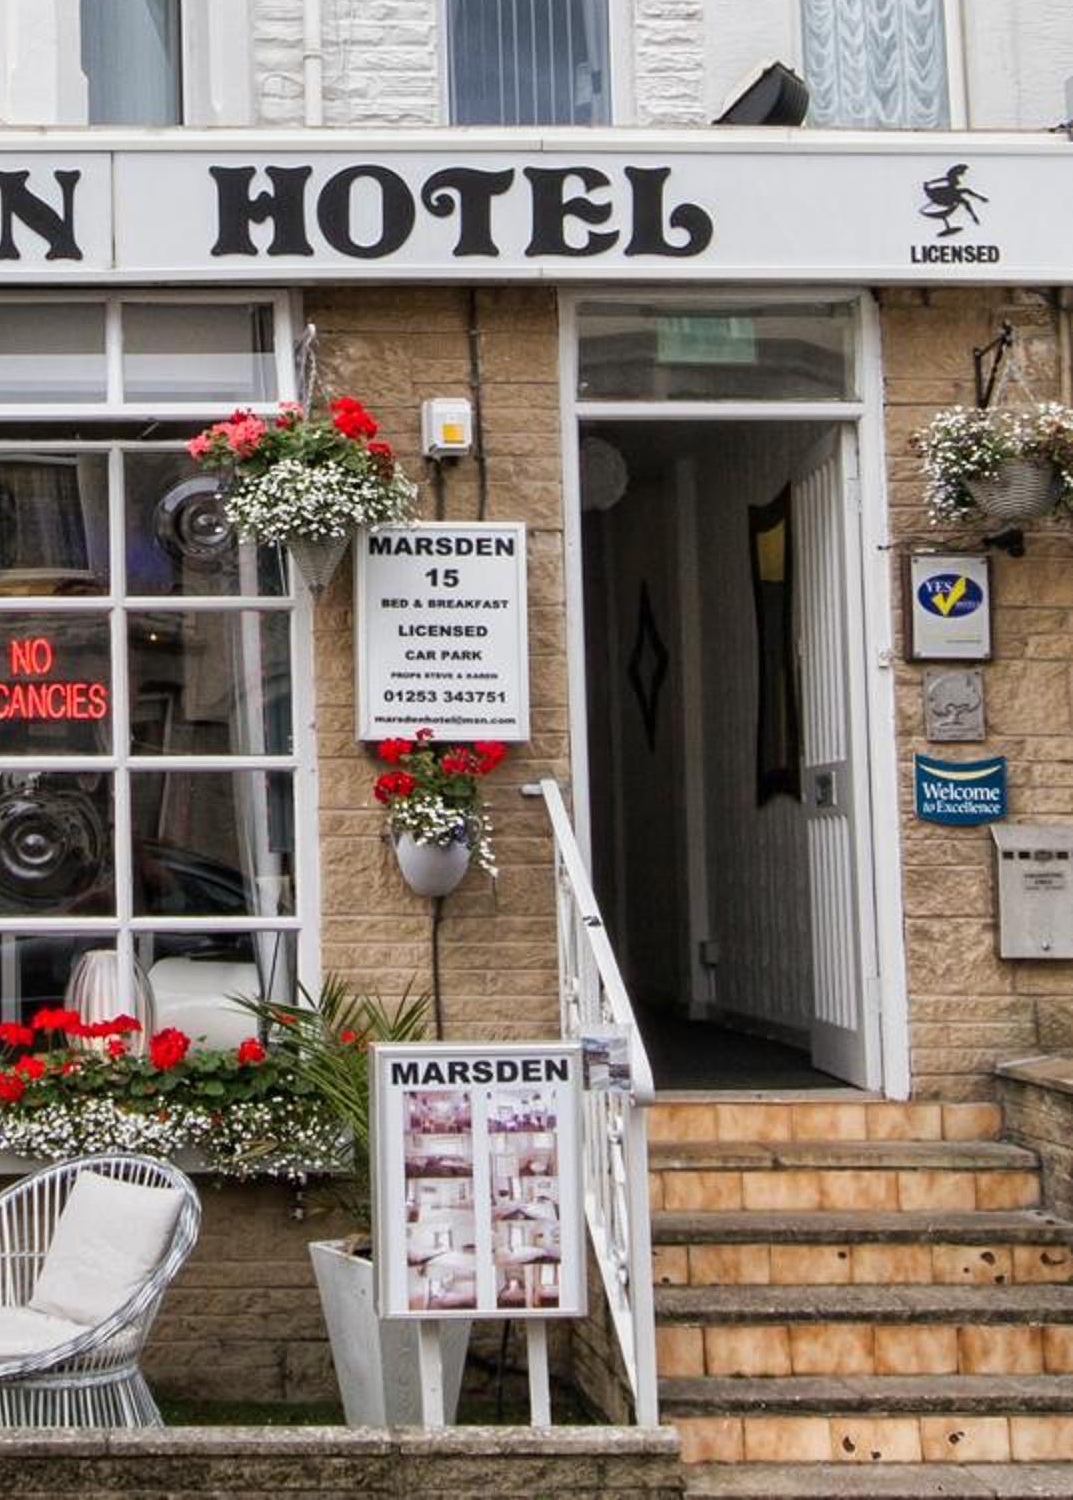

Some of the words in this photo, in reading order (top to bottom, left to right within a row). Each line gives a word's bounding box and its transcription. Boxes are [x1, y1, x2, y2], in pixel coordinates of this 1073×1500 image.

[209, 164, 714, 261] HOTEL
[910, 245, 1000, 264] LICENSED
[368, 536, 515, 557] MARSDEN
[425, 568, 460, 588] 15
[380, 598, 409, 609] BED
[412, 598, 424, 609] &
[427, 599, 509, 609] BREAKFAST
[398, 624, 488, 637] LICENSED
[7, 636, 55, 678] NO
[404, 649, 436, 661] CAR
[440, 650, 483, 661] PARK
[390, 671, 421, 680] PROPS
[383, 689, 438, 704] 01253
[443, 690, 507, 704] 343751
[922, 781, 1000, 801] Welcome
[936, 801, 1001, 814] Excellence
[391, 1059, 569, 1085] MARSDEN
